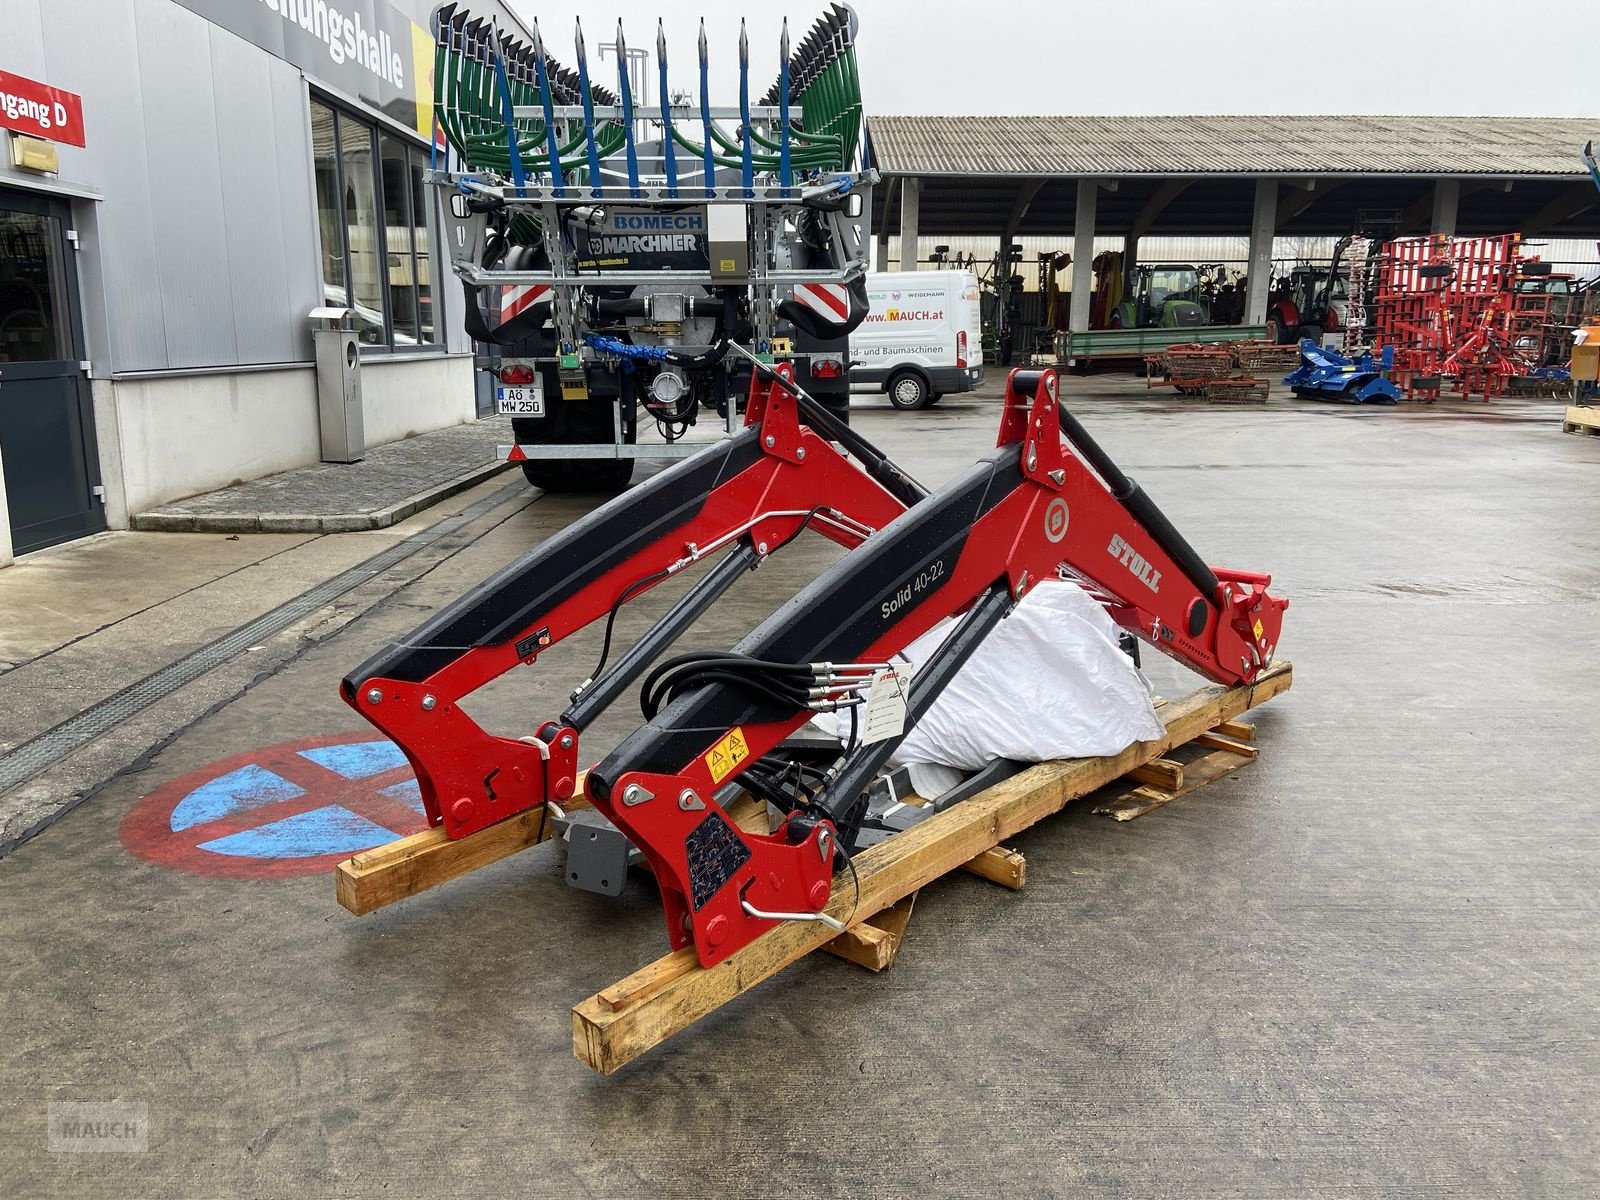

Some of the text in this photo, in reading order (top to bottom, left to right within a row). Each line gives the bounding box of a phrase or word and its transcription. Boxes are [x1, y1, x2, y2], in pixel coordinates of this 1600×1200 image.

[54, 101, 67, 127] D
[614, 216, 703, 230] BOMECH
[604, 234, 697, 254] MARCHNER
[863, 310, 944, 322] ww.MAUCH.at
[864, 347, 880, 356] und
[883, 346, 943, 355] Baumaschinen
[508, 389, 523, 400] AÖ
[502, 401, 540, 412] MW 250
[1107, 533, 1162, 594] STOLL
[881, 560, 945, 619] Solid 40-22
